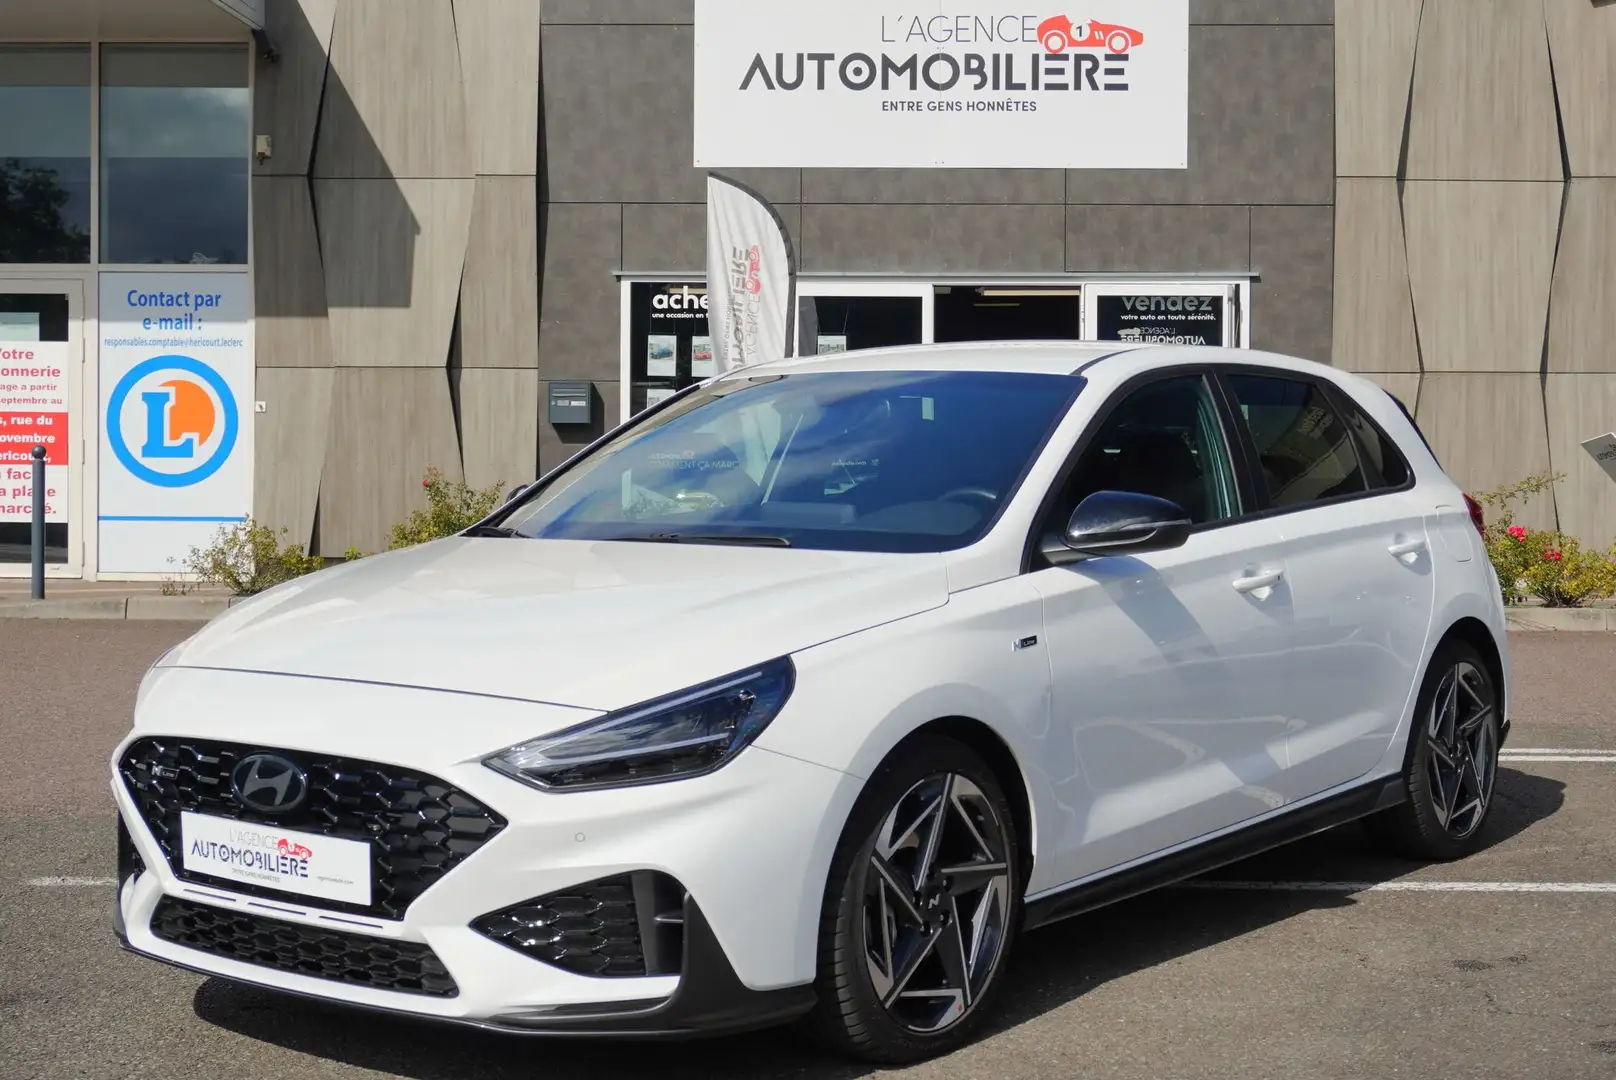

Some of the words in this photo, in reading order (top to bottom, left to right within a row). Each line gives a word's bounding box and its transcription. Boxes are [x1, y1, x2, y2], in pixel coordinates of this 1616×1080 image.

[882, 15, 1038, 43] L'AGENCE
[882, 101, 923, 111] ENTRE
[927, 101, 962, 112] GENS
[966, 98, 1037, 112] HONNÊTES
[127, 289, 190, 307] Contact
[194, 294, 222, 311] par
[1121, 296, 1212, 311] vendez
[143, 313, 193, 330] e-mail
[1187, 312, 1216, 320] sérénité.
[30, 383, 57, 392] partir
[10, 416, 33, 425] rue
[37, 415, 53, 425] du
[7, 468, 31, 480] fac
[12, 485, 56, 499] plae
